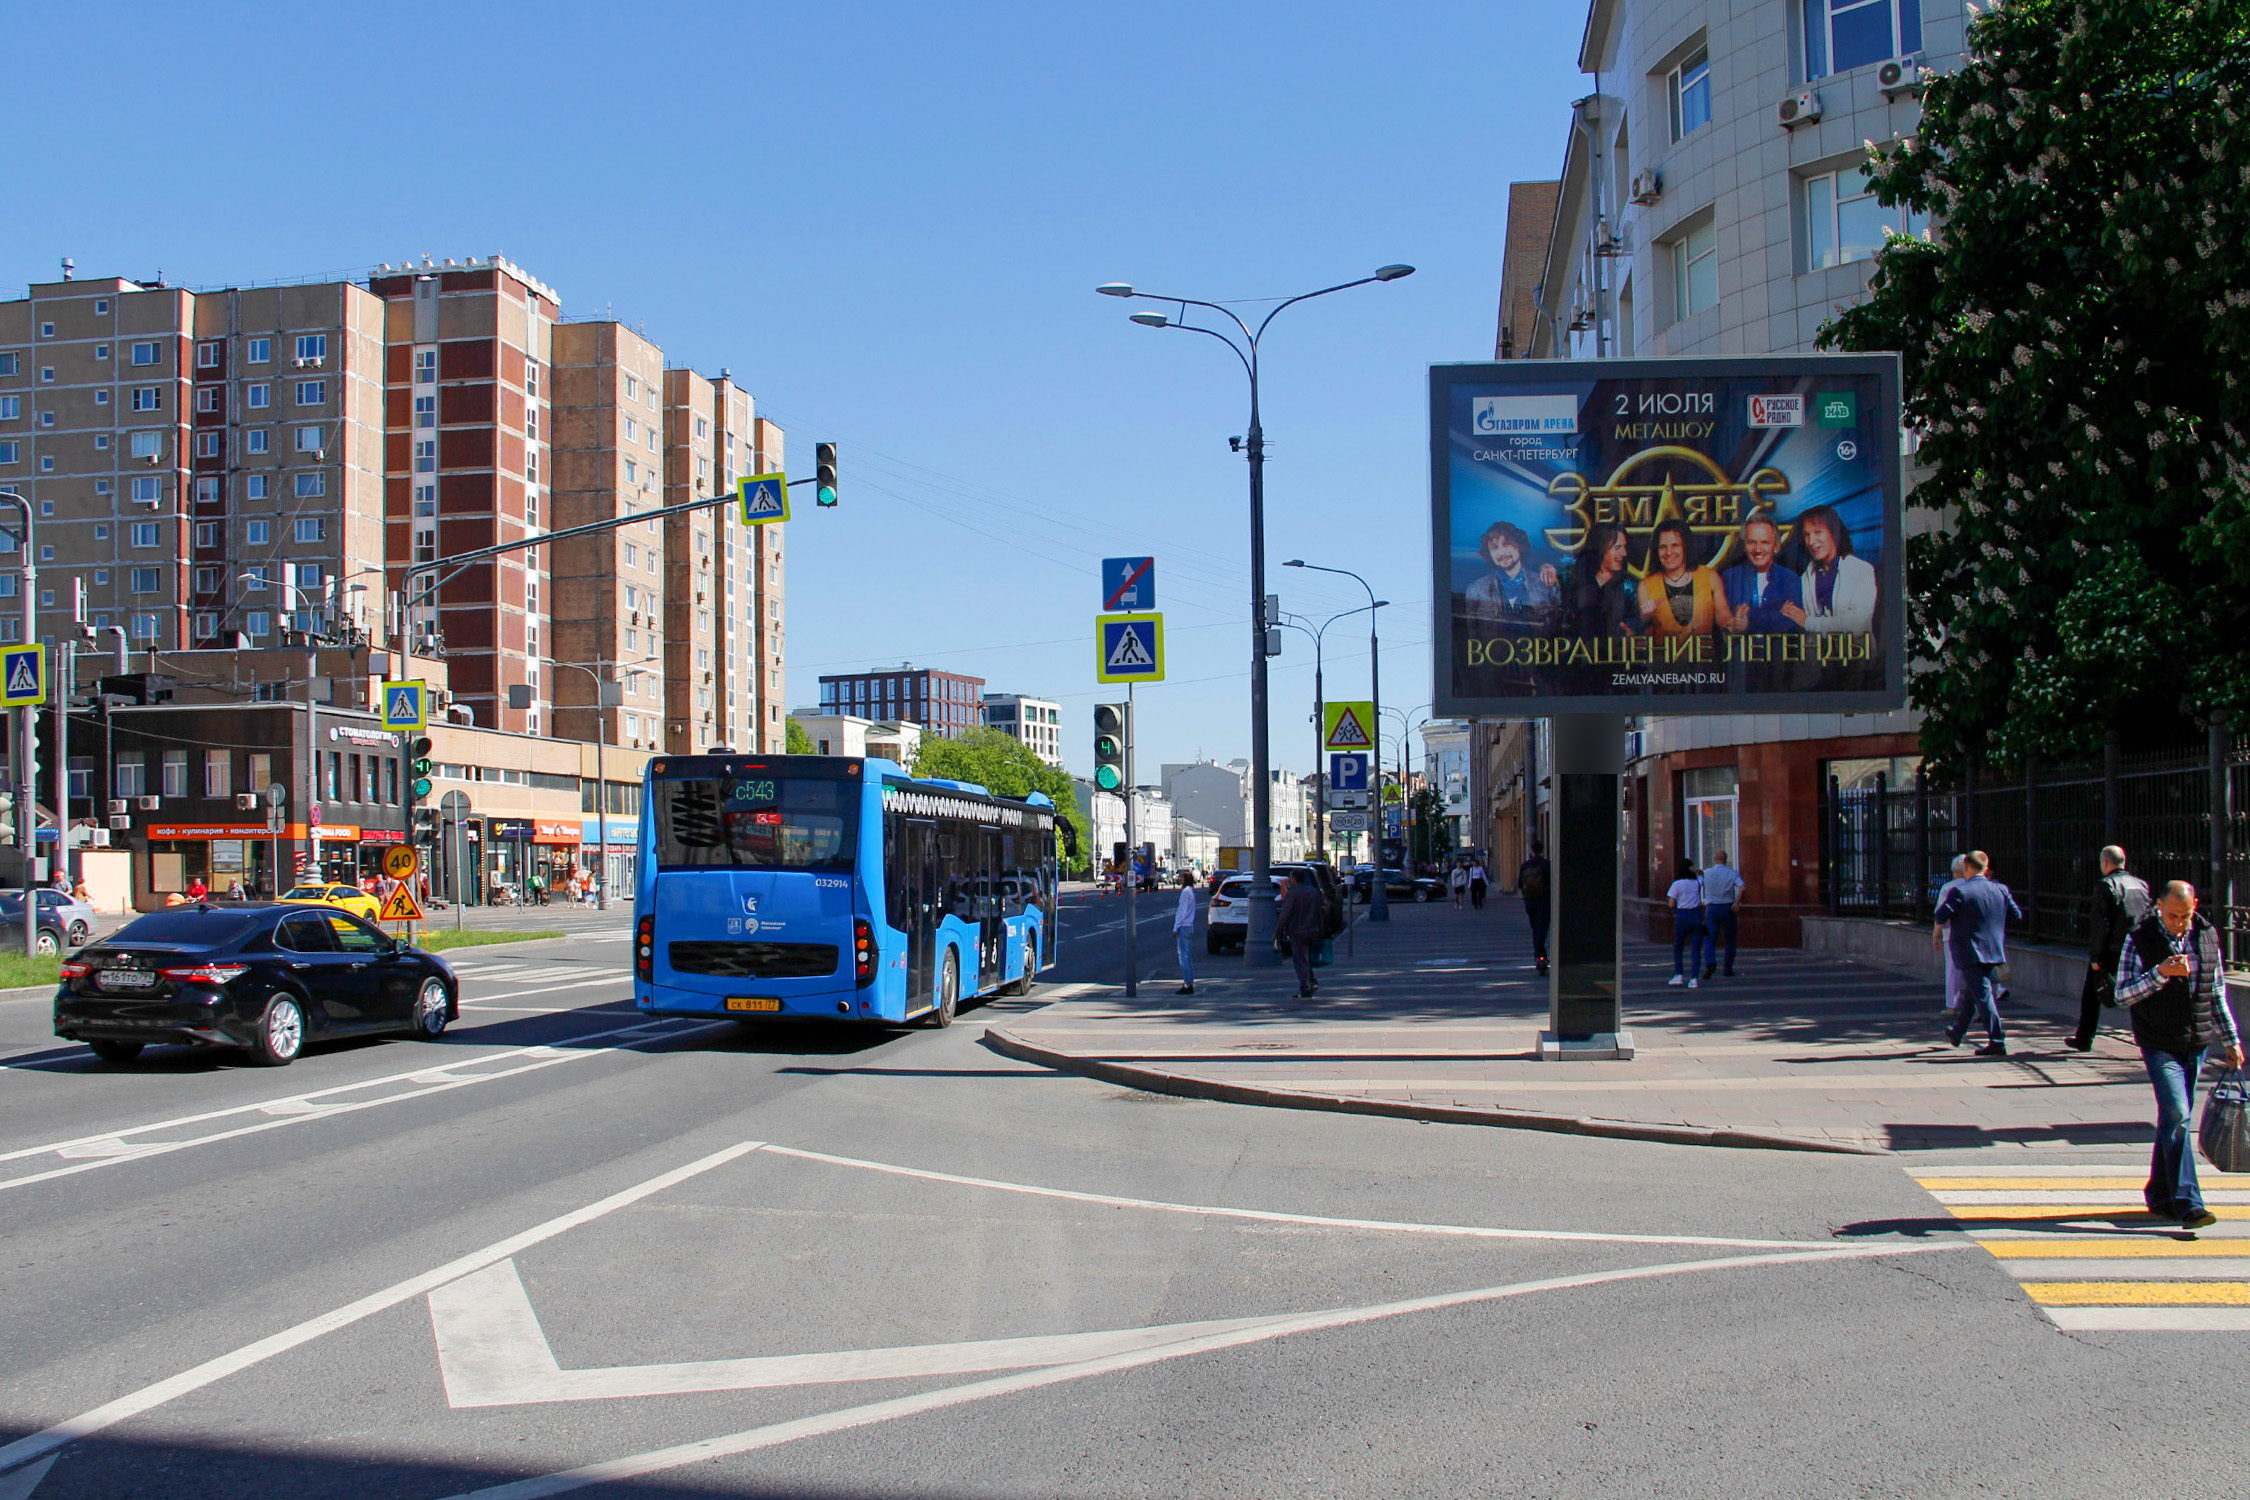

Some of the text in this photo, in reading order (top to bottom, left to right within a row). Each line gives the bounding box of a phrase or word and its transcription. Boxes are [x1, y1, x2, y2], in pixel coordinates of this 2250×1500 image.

[1615, 393, 1713, 414] 2 ИЮЛЯ
[1766, 398, 1799, 411] РУССКОЕ
[1825, 402, 1849, 418] НТВ
[1496, 418, 1574, 430] ГАЗПРОМ АРЕНА
[1766, 411, 1791, 424] РАДИО
[1615, 421, 1715, 440] МЕГАШОУ
[1509, 437, 1543, 447] город
[1473, 448, 1578, 461] САНКТ-ПЕТЕРБУРГ
[1467, 632, 1871, 670] ВОЗВРАЩЕНИЕ ЛЕГЕНДЫ
[1612, 672, 1726, 686] ZEMLYANEBAND.RU
[1340, 757, 1358, 788] P
[390, 854, 411, 869] 40
[815, 879, 848, 889] 032914
